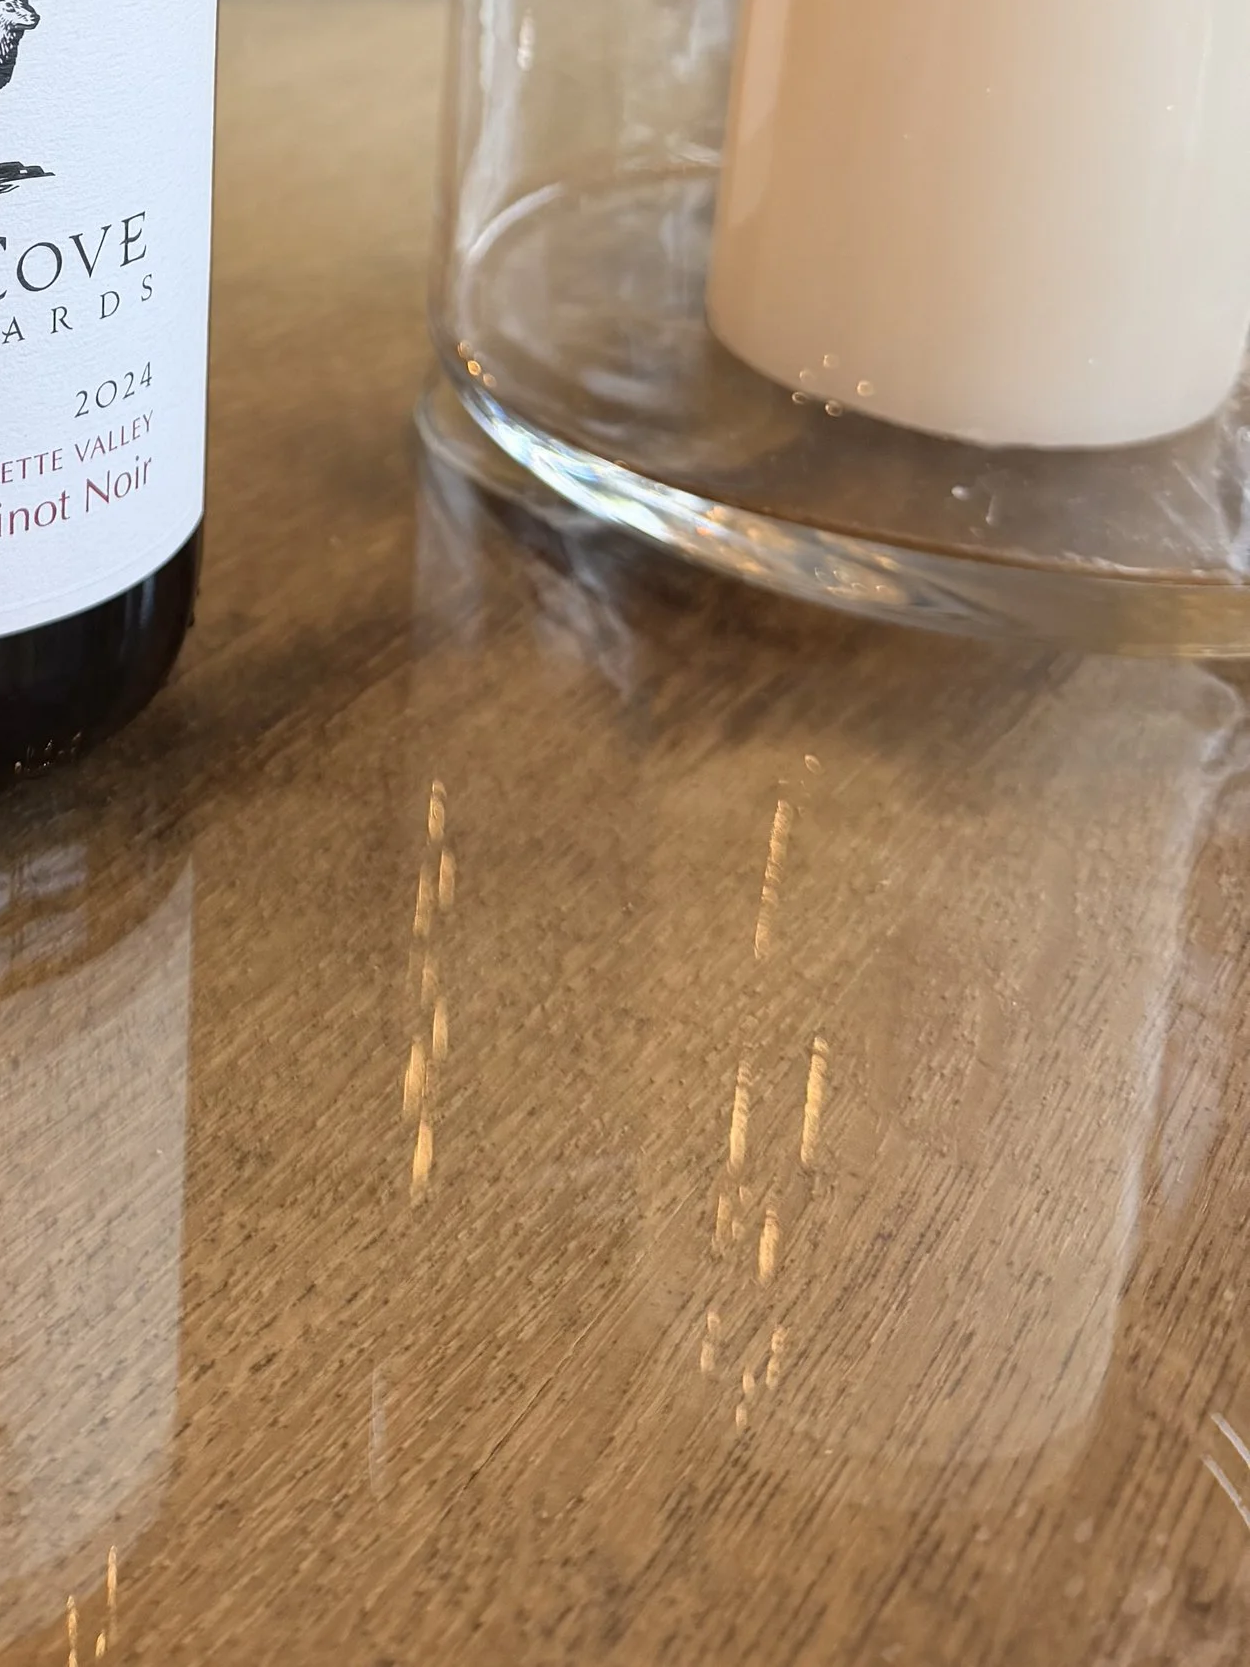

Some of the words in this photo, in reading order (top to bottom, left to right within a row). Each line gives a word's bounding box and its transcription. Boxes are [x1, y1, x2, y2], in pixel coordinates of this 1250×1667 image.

[74, 361, 153, 418] 2024
[74, 410, 154, 463] VALLEY
[84, 454, 153, 513] Noir
